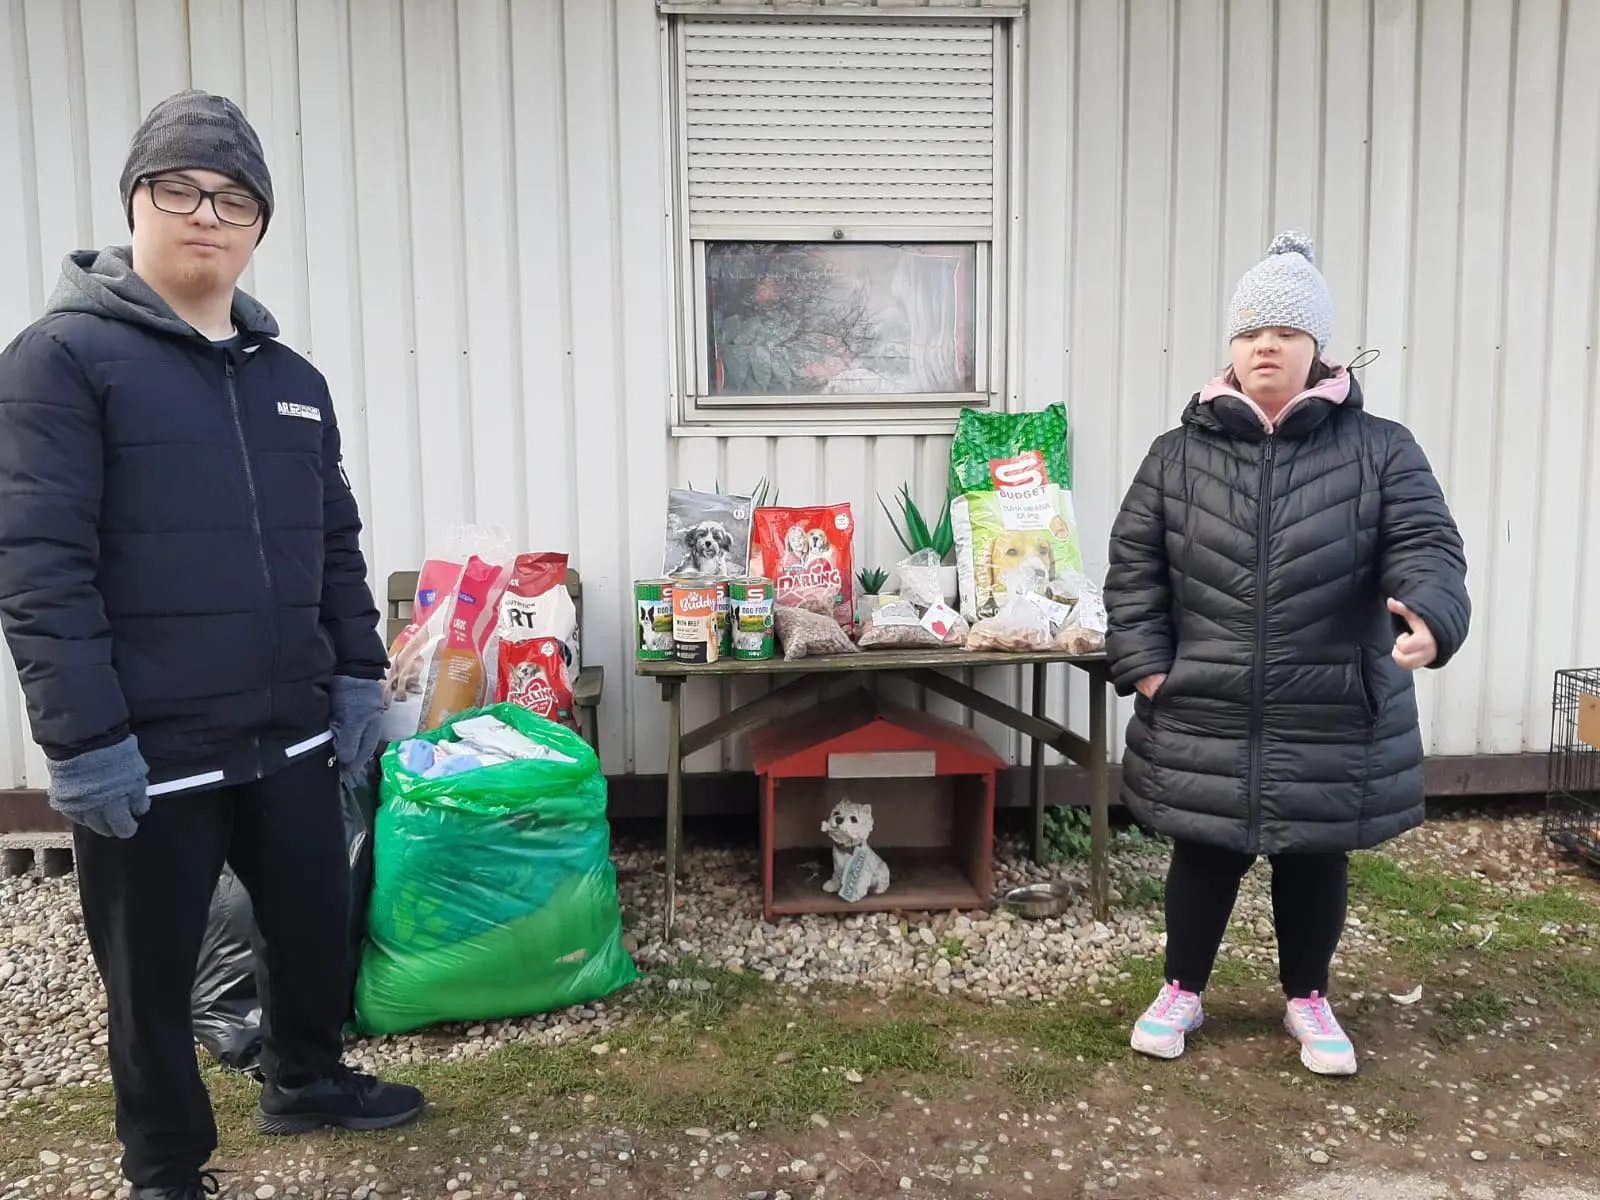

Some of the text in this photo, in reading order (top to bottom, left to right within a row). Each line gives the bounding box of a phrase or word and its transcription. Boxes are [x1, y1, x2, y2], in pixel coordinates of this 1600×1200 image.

[999, 487, 1047, 500] BUDGET
[777, 569, 841, 593] DARLING
[680, 592, 716, 612] Buddy
[741, 606, 768, 614] DOG FOOD
[687, 619, 700, 627] BEEF
